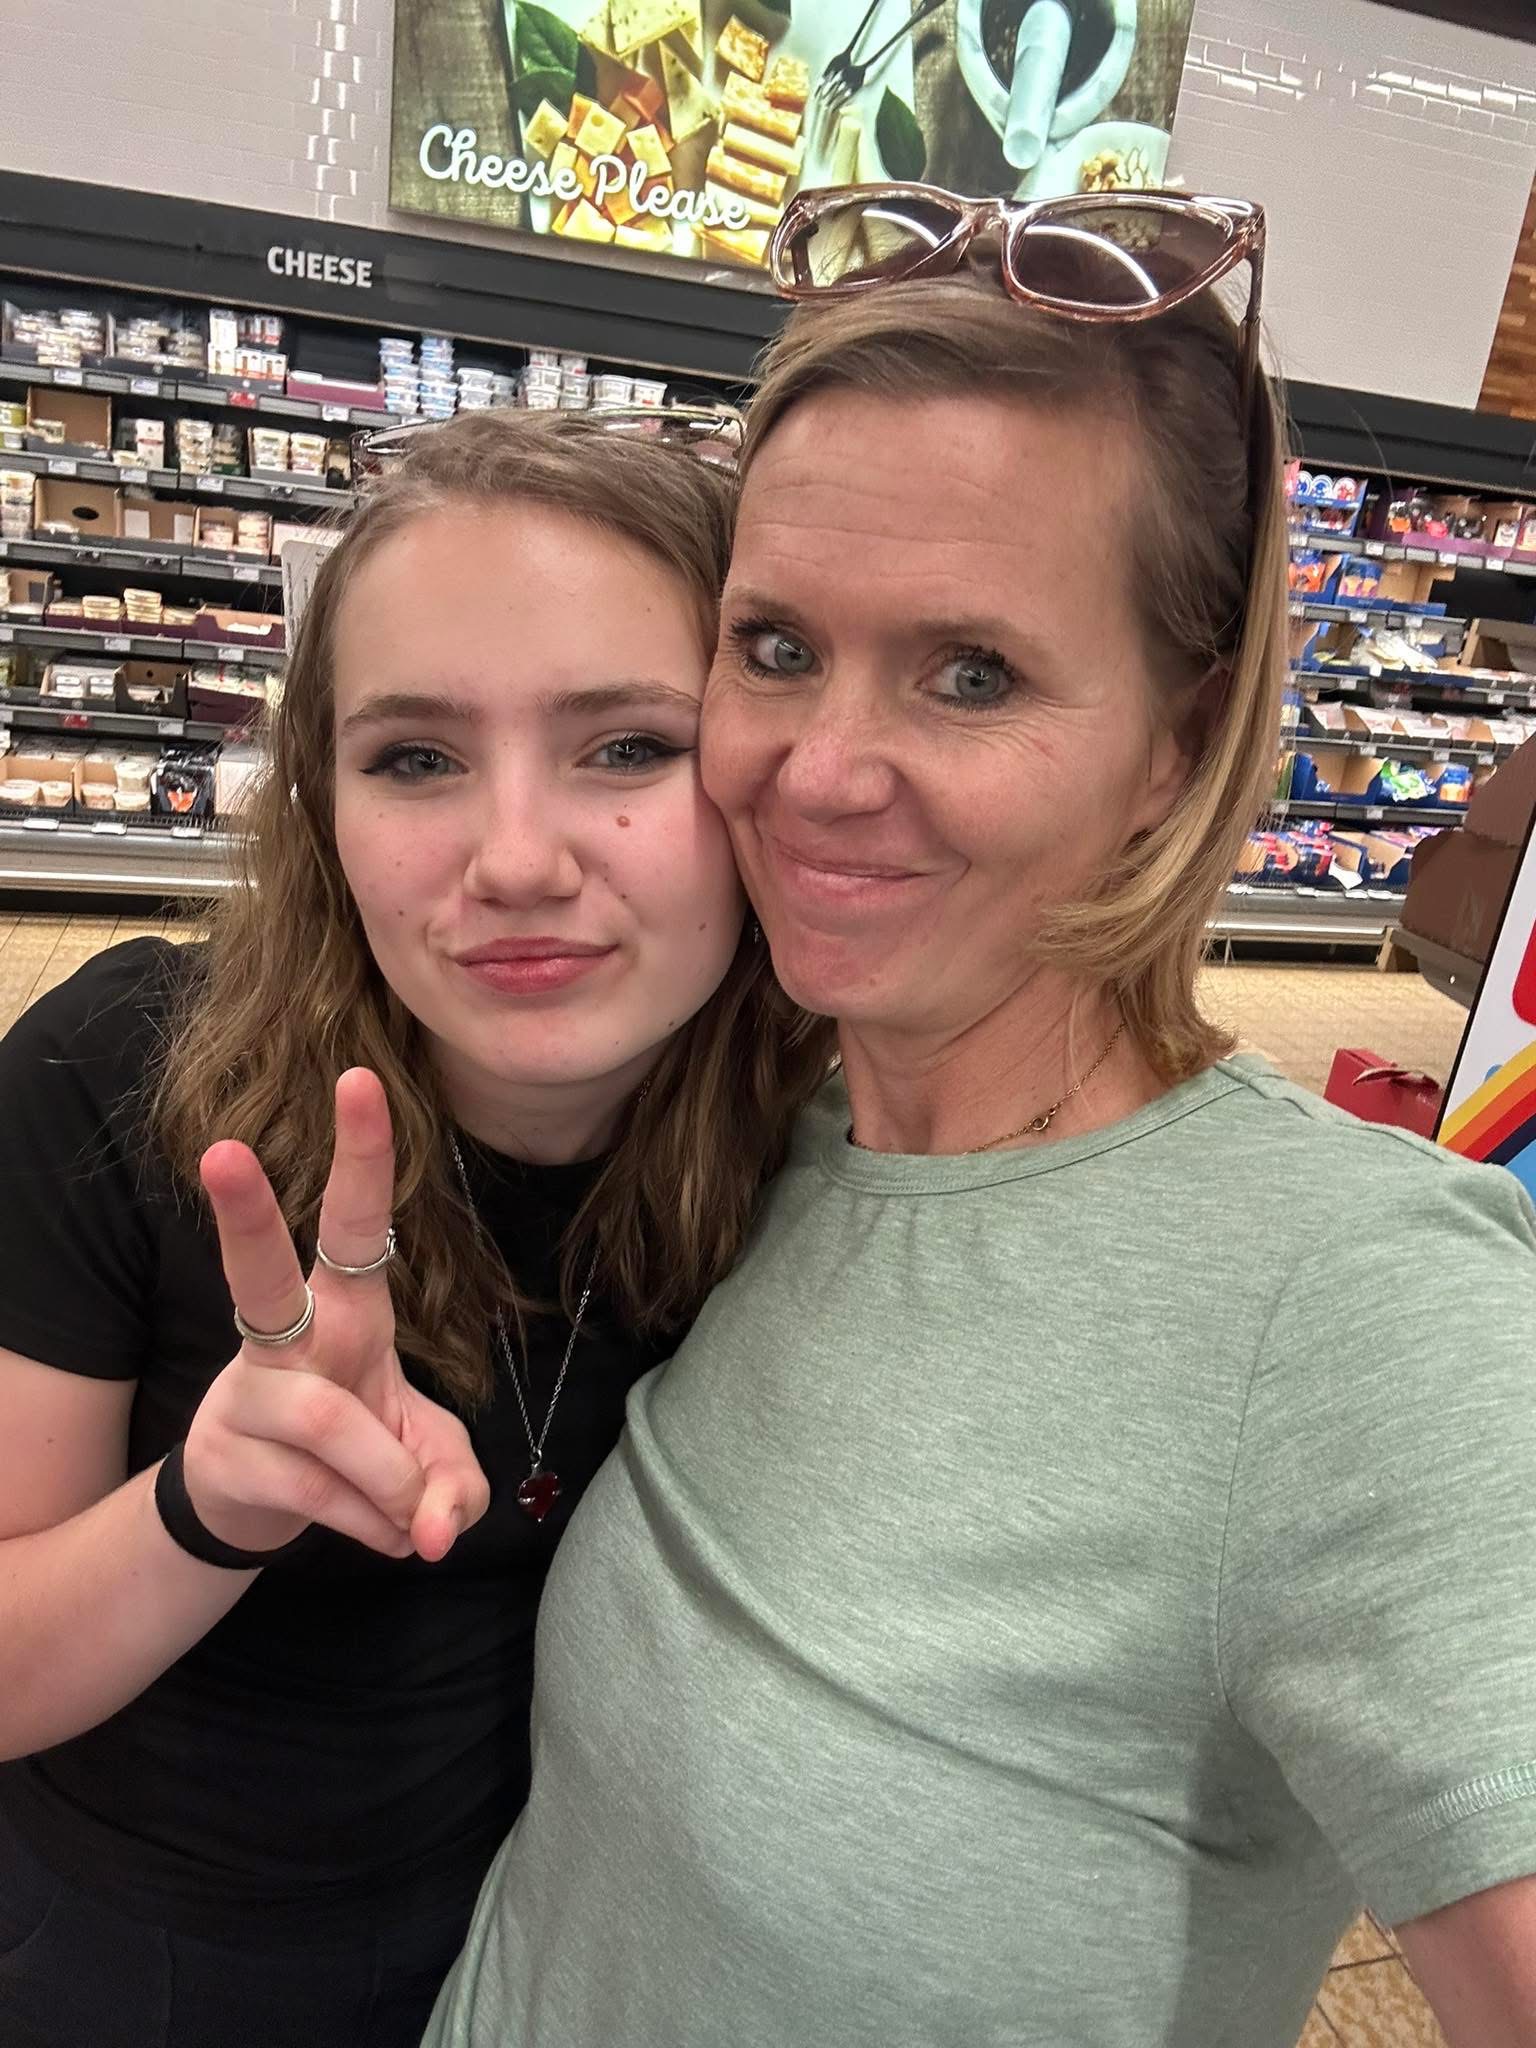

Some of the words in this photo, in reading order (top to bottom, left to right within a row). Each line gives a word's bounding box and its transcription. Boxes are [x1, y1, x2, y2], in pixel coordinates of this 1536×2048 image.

[419, 123, 583, 200] Cheese
[590, 154, 751, 229] Please
[267, 245, 373, 289] CHEESE
